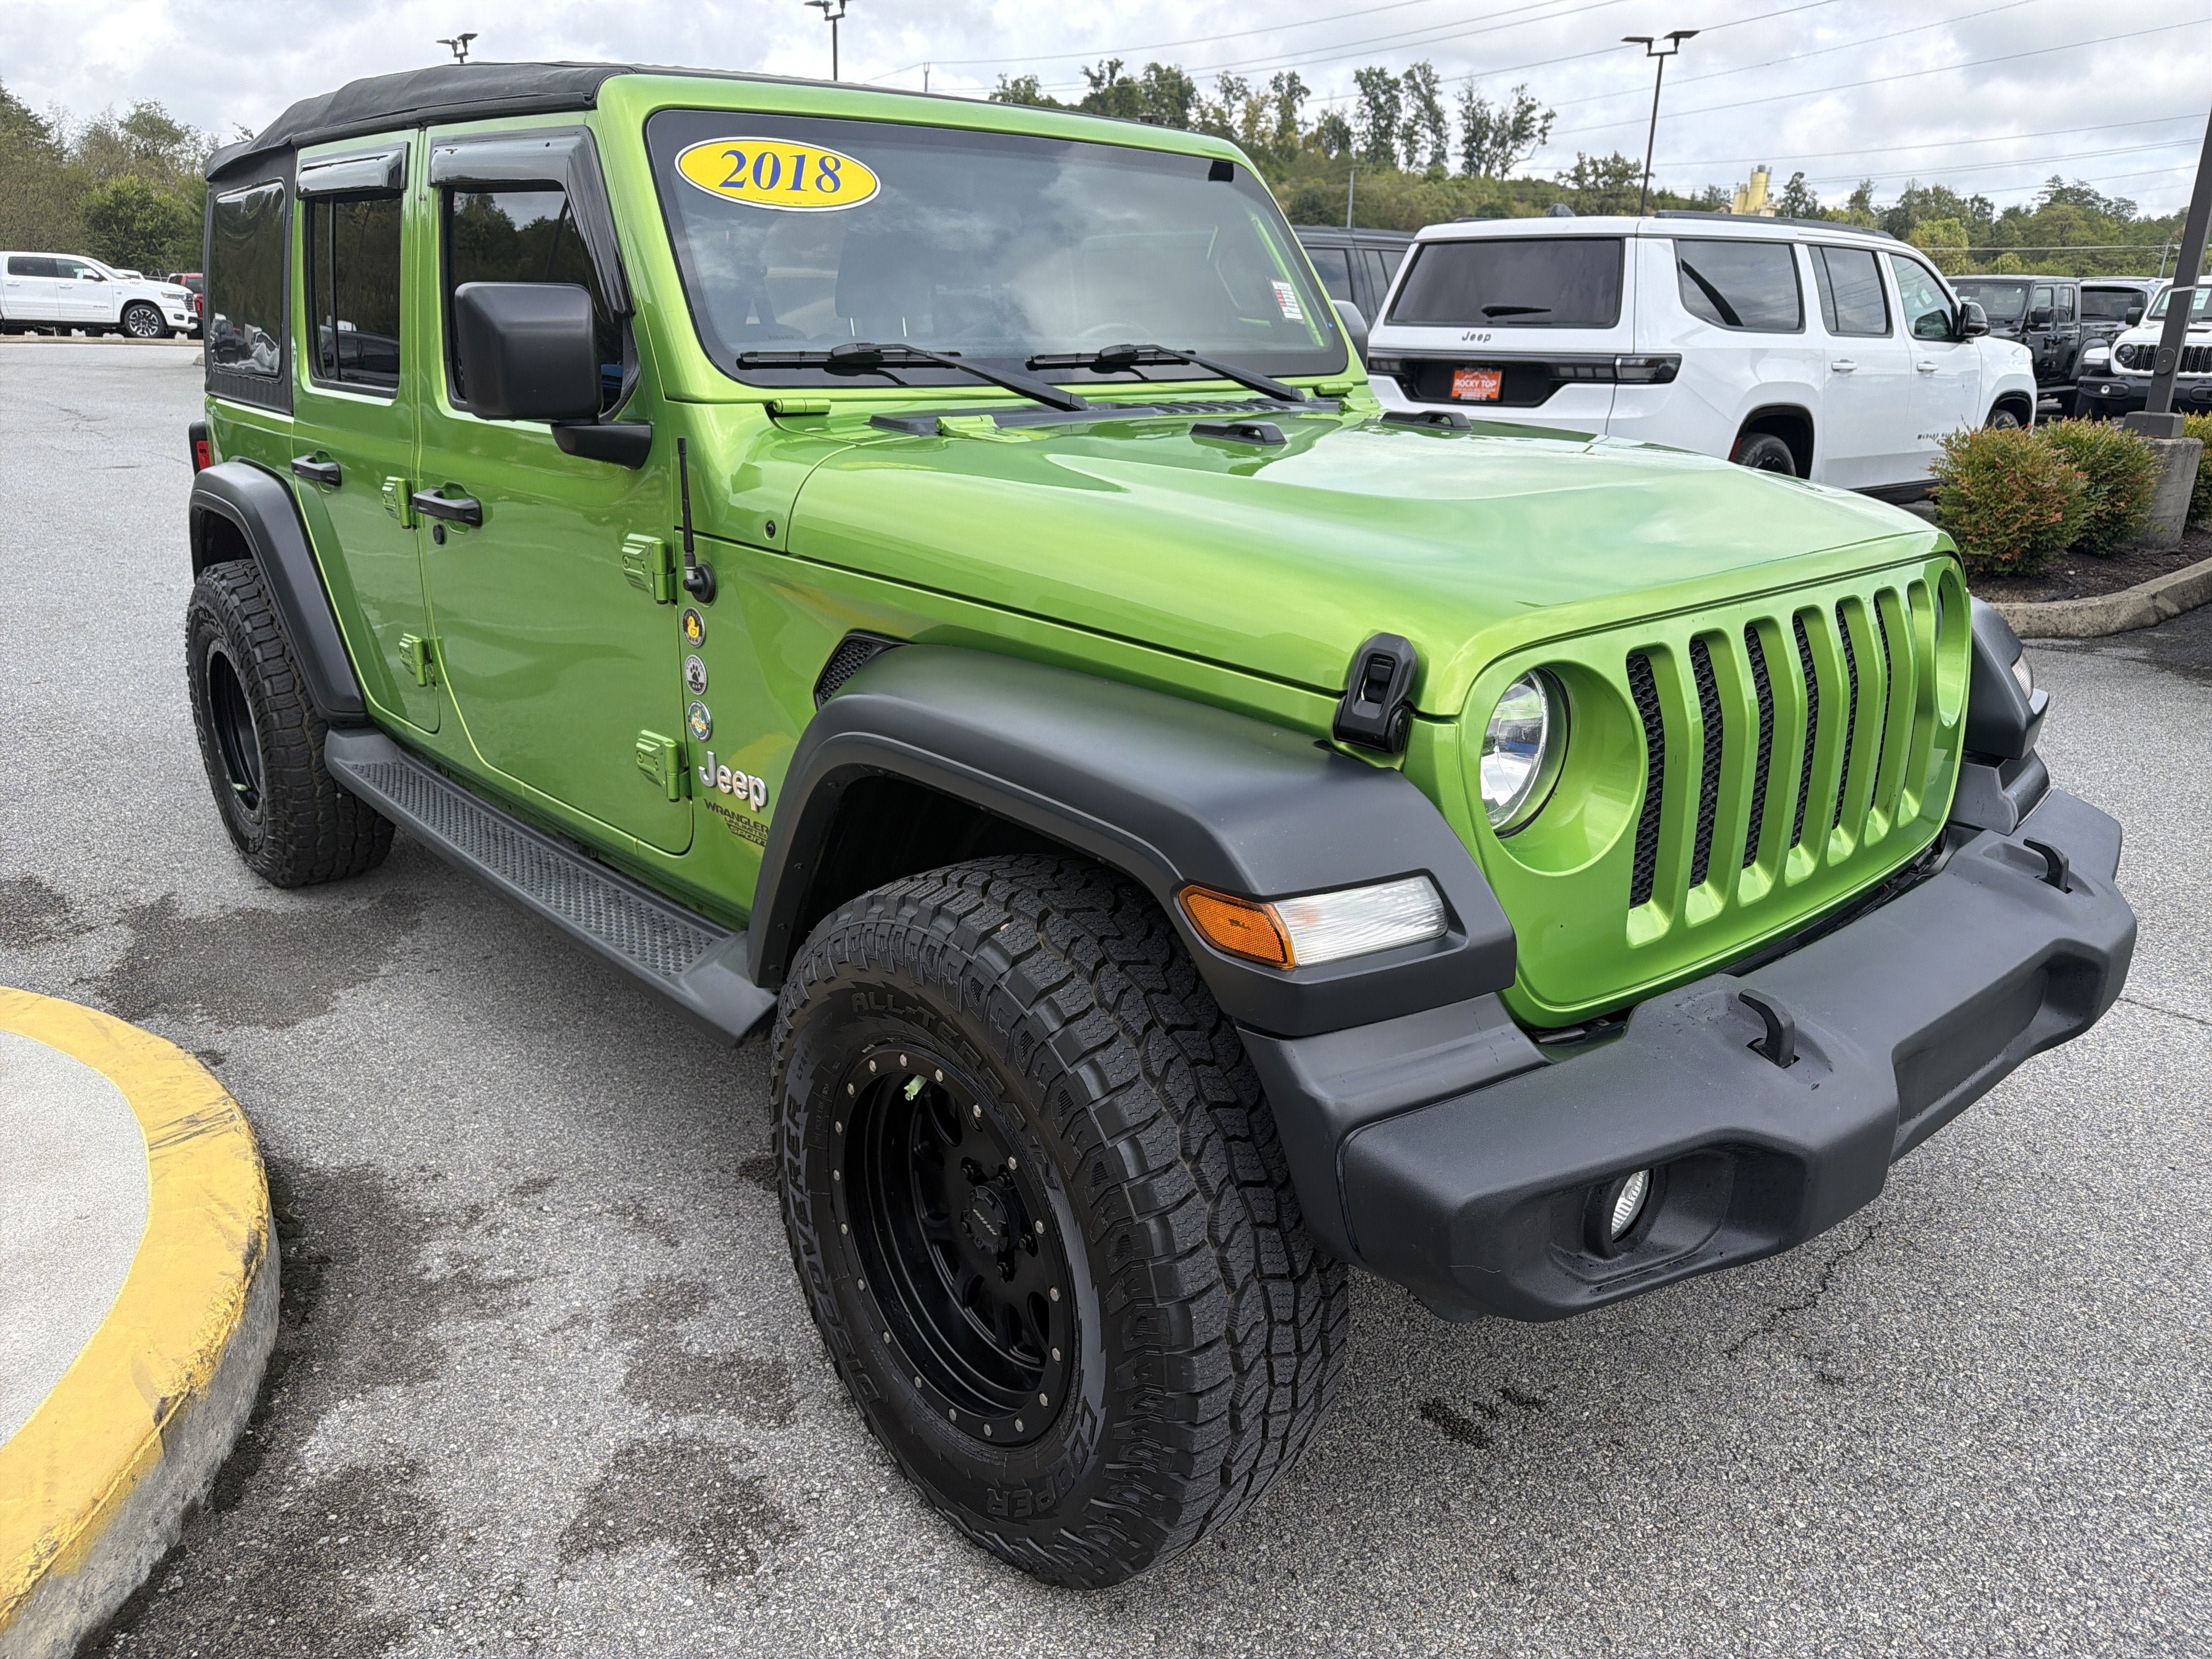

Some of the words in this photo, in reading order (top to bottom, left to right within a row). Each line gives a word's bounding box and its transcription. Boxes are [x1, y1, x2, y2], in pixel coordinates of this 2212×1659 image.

[719, 150, 841, 193] 2018
[1462, 331, 1492, 343] Jeep
[1454, 379, 1479, 388] ROCKY
[1481, 379, 1497, 388] TOP
[698, 751, 768, 813] Jeep
[704, 798, 769, 835] WRANGLER
[786, 1093, 881, 1403] DISCOVERER
[987, 1396, 1098, 1519] COOPER
